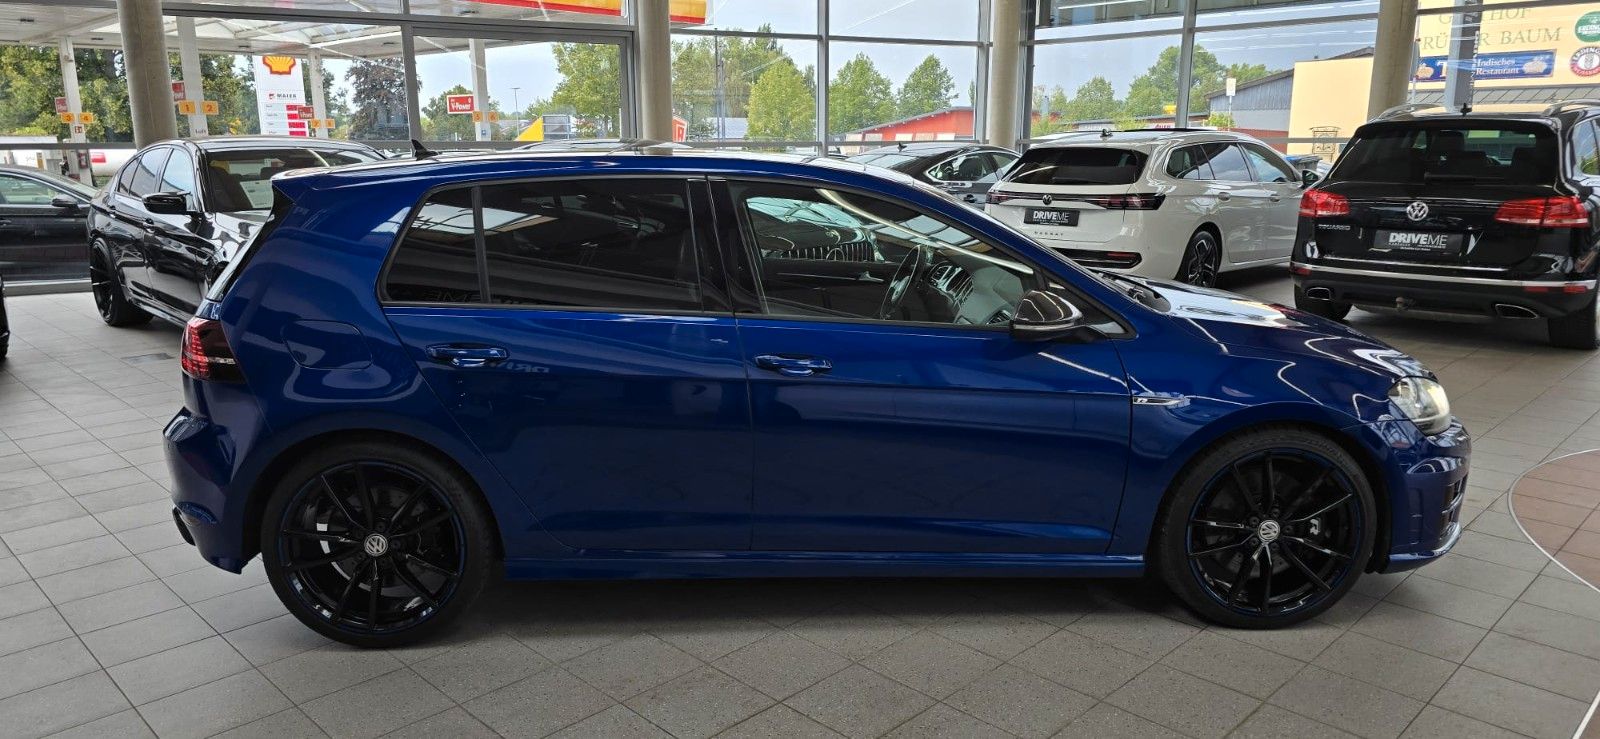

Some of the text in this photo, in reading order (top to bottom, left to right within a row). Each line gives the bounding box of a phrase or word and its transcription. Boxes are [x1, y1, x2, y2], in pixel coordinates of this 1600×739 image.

[1500, 26, 1562, 45] BAUM
[1477, 57, 1515, 67] Indisches
[1476, 66, 1520, 76] Restaurant
[206, 104, 213, 112] 2
[450, 102, 471, 111] V-Power
[1033, 210, 1071, 221] DRIVEME
[1389, 232, 1448, 246] DRIVEME
